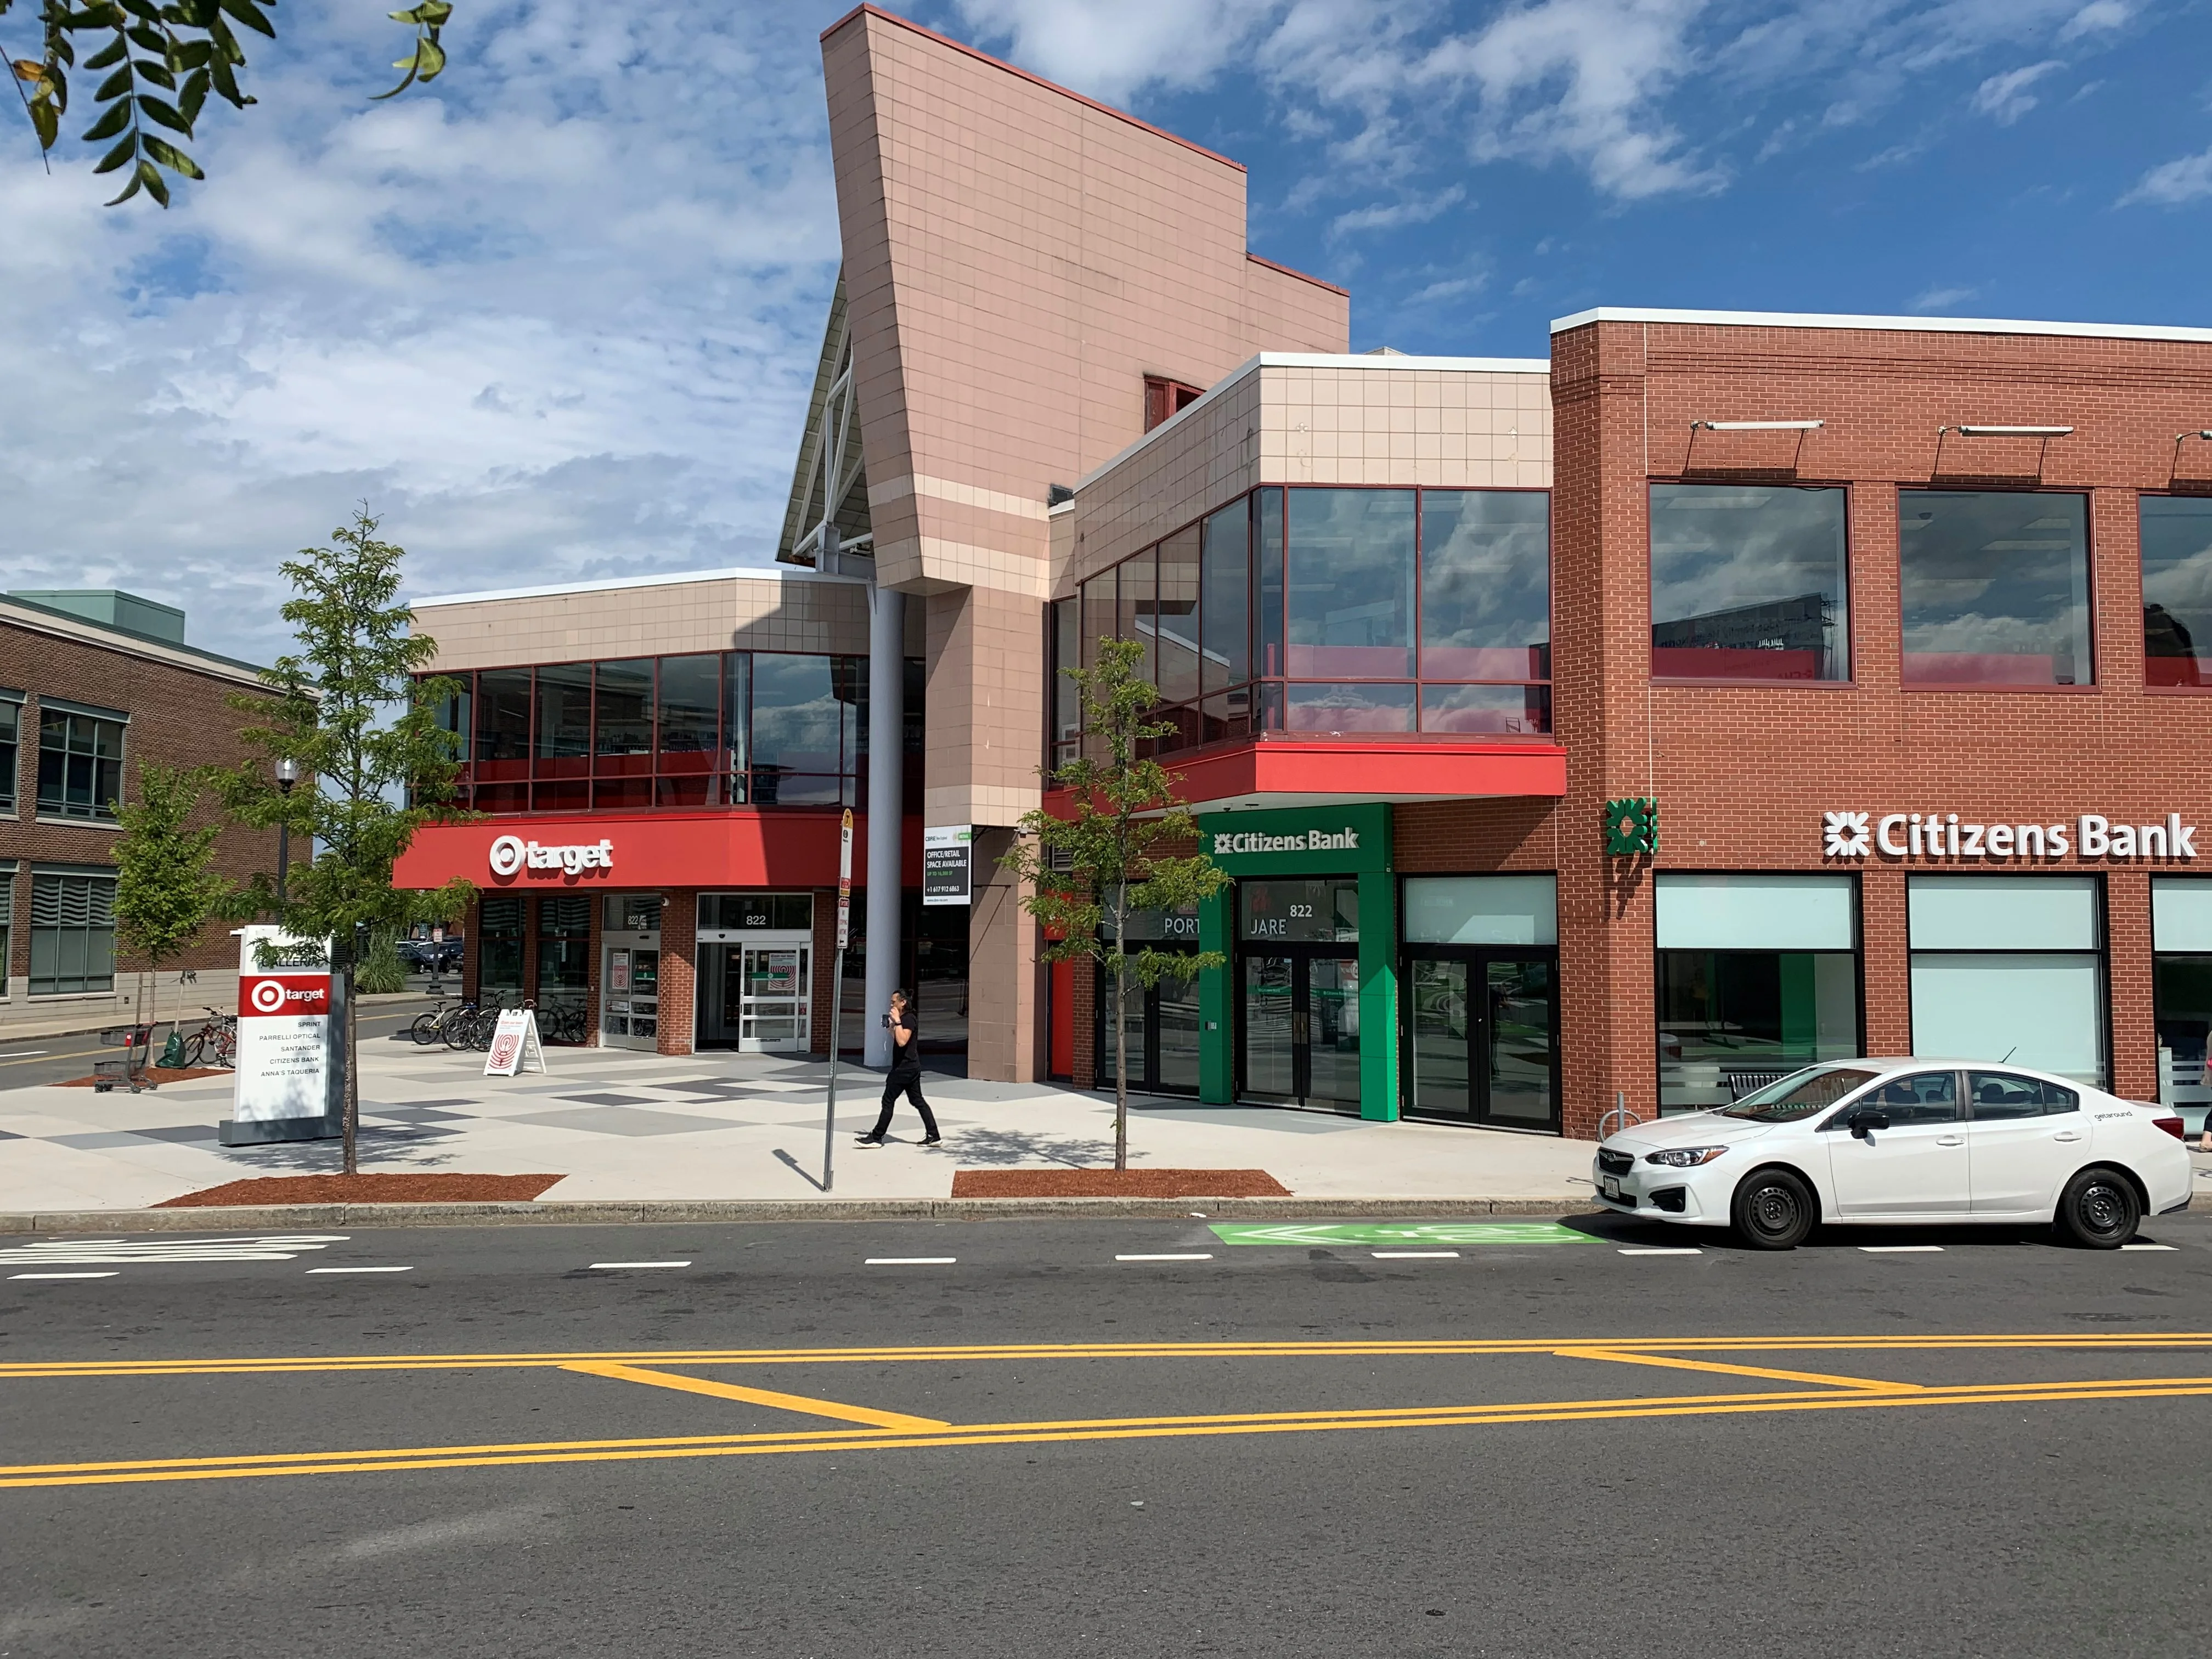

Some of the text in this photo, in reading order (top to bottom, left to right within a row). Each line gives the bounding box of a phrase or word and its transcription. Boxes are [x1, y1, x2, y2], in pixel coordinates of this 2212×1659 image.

[1233, 827, 1359, 853] Citizens Bank
[1876, 813, 2197, 856] Citizens Bank
[526, 839, 613, 875] target
[927, 850, 960, 859] OFFICE/RETAIL
[1290, 905, 1312, 917] 822
[628, 915, 638, 925] 822
[746, 915, 766, 925] 822
[1165, 918, 1286, 934] PORT UARE
[285, 988, 324, 1002] target
[2094, 1111, 2132, 1121] getaround
